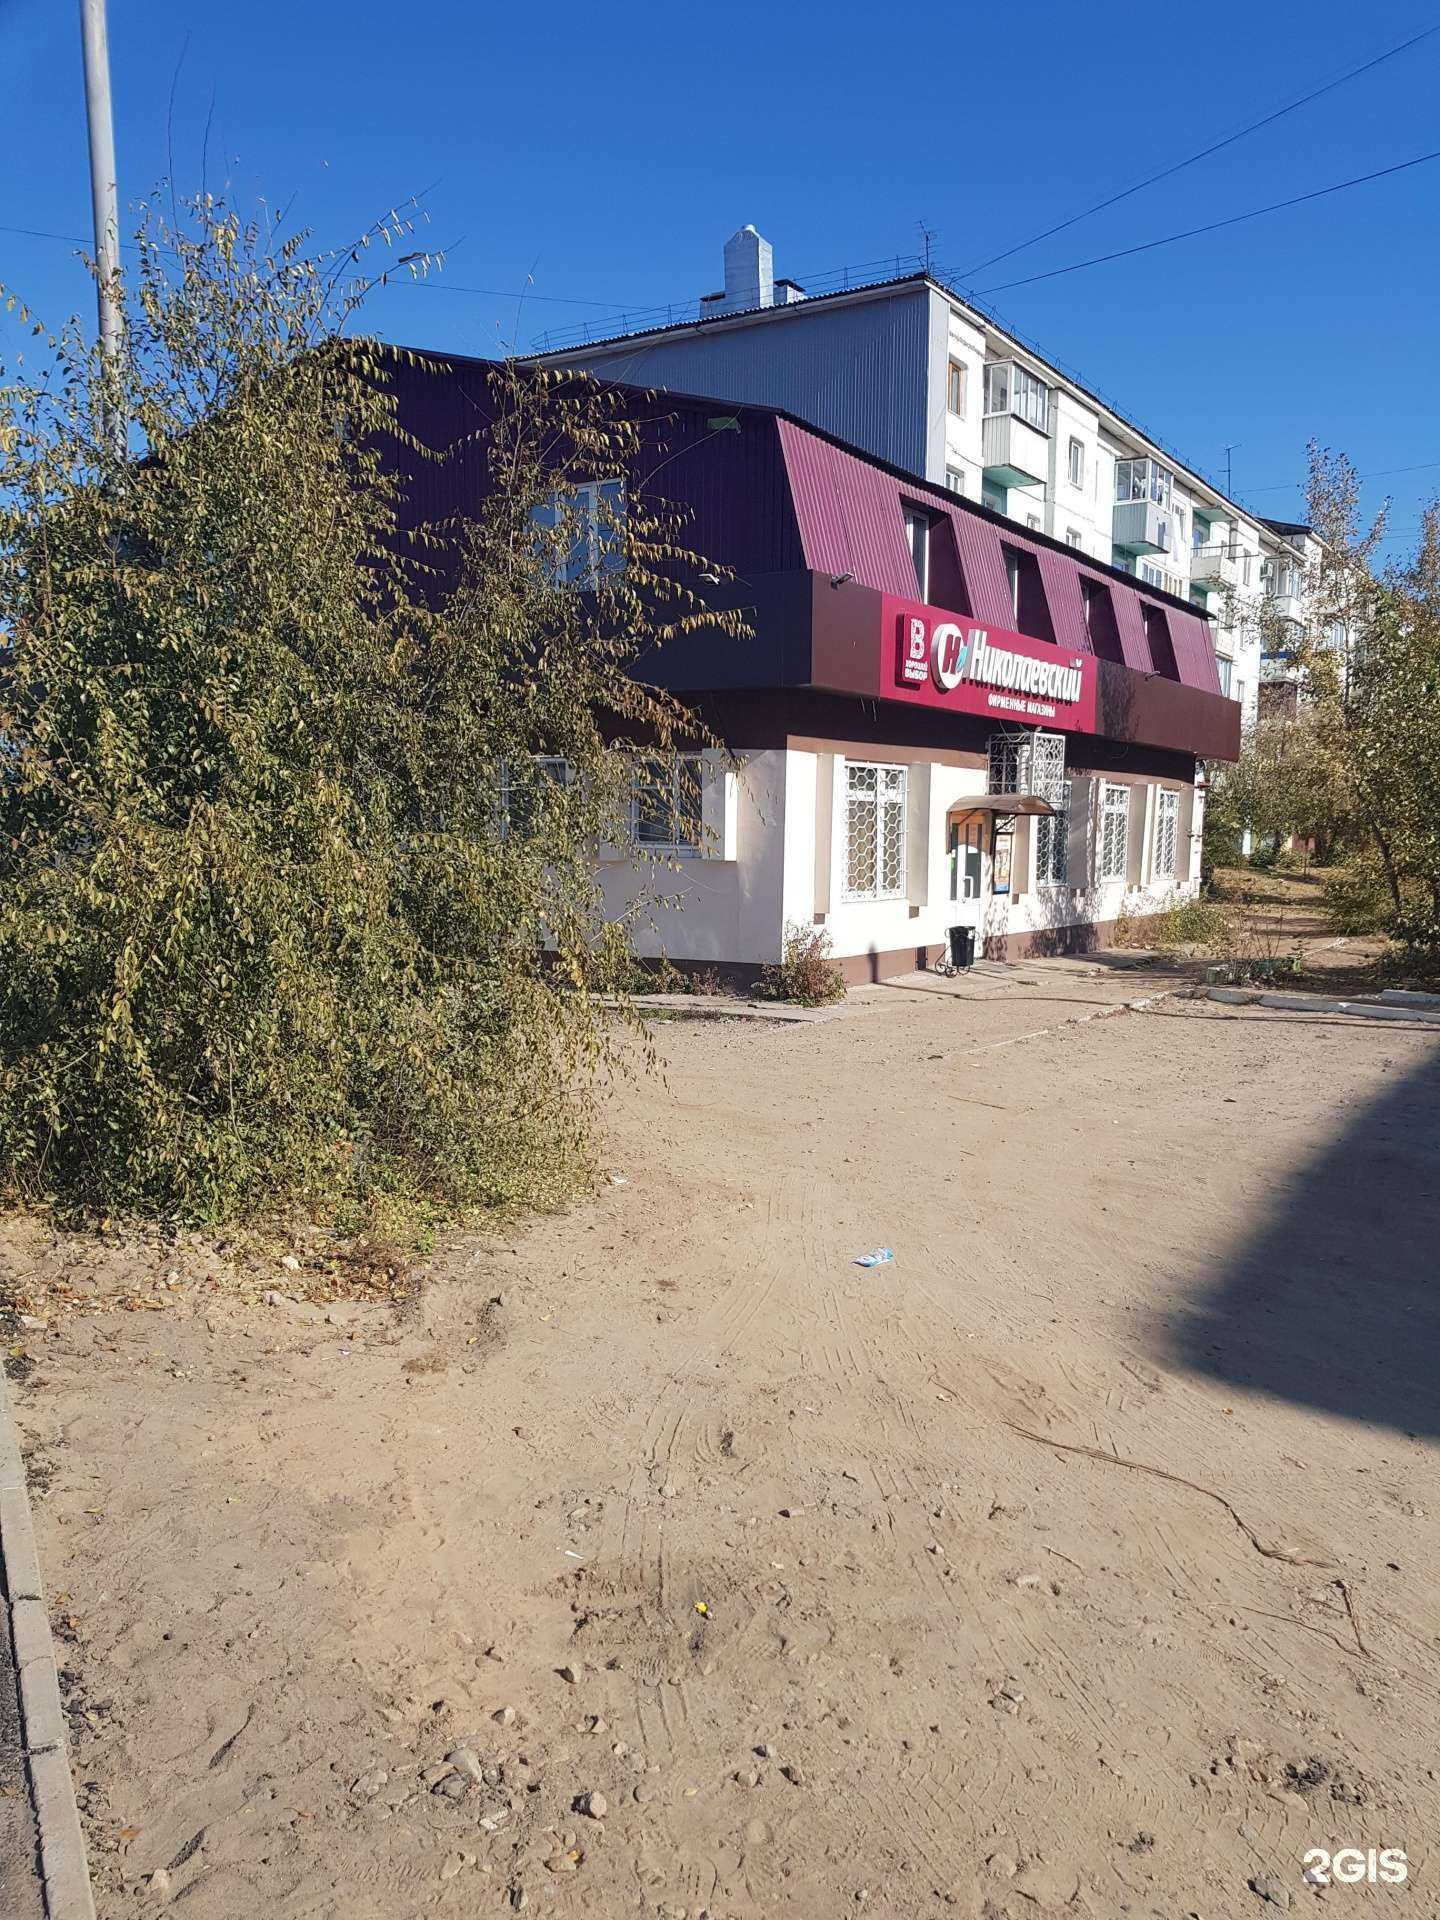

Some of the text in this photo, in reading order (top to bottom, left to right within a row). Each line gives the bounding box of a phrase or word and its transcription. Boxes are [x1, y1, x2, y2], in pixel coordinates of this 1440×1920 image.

[904, 668, 928, 681] ВЫБОР
[969, 629, 1083, 703] Николаевский
[988, 693, 1056, 718] ФИРМЕННЫЕ МАГАЗИНЫ
